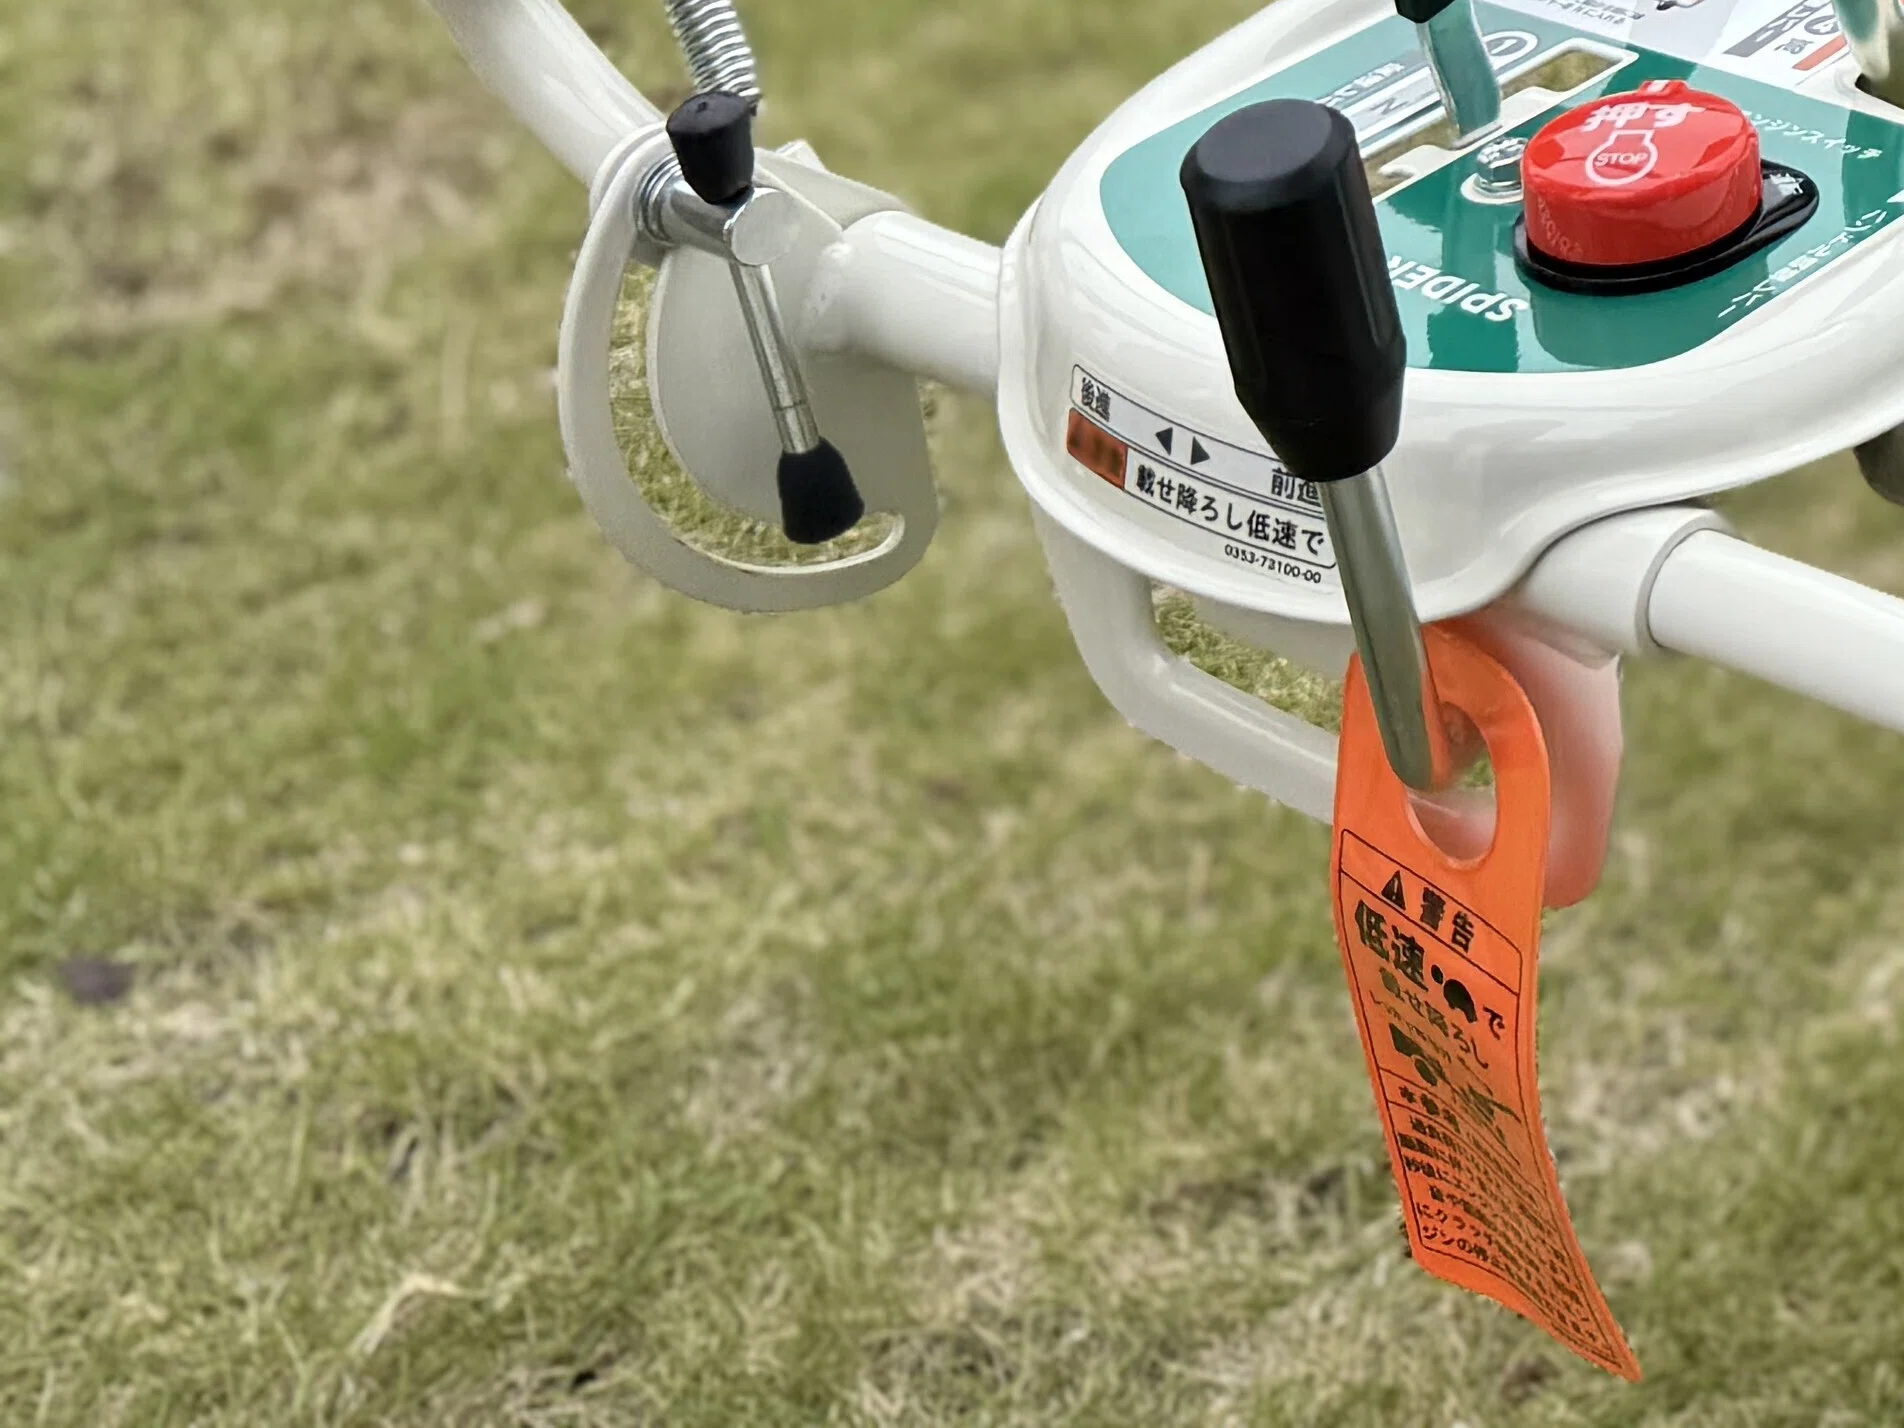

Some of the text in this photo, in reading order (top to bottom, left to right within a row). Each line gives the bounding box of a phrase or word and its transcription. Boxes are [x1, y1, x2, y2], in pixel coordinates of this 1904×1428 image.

[1580, 101, 1706, 132] 押す
[1743, 110, 1882, 158] ンジンスイッチ
[1593, 151, 1649, 167] STOP
